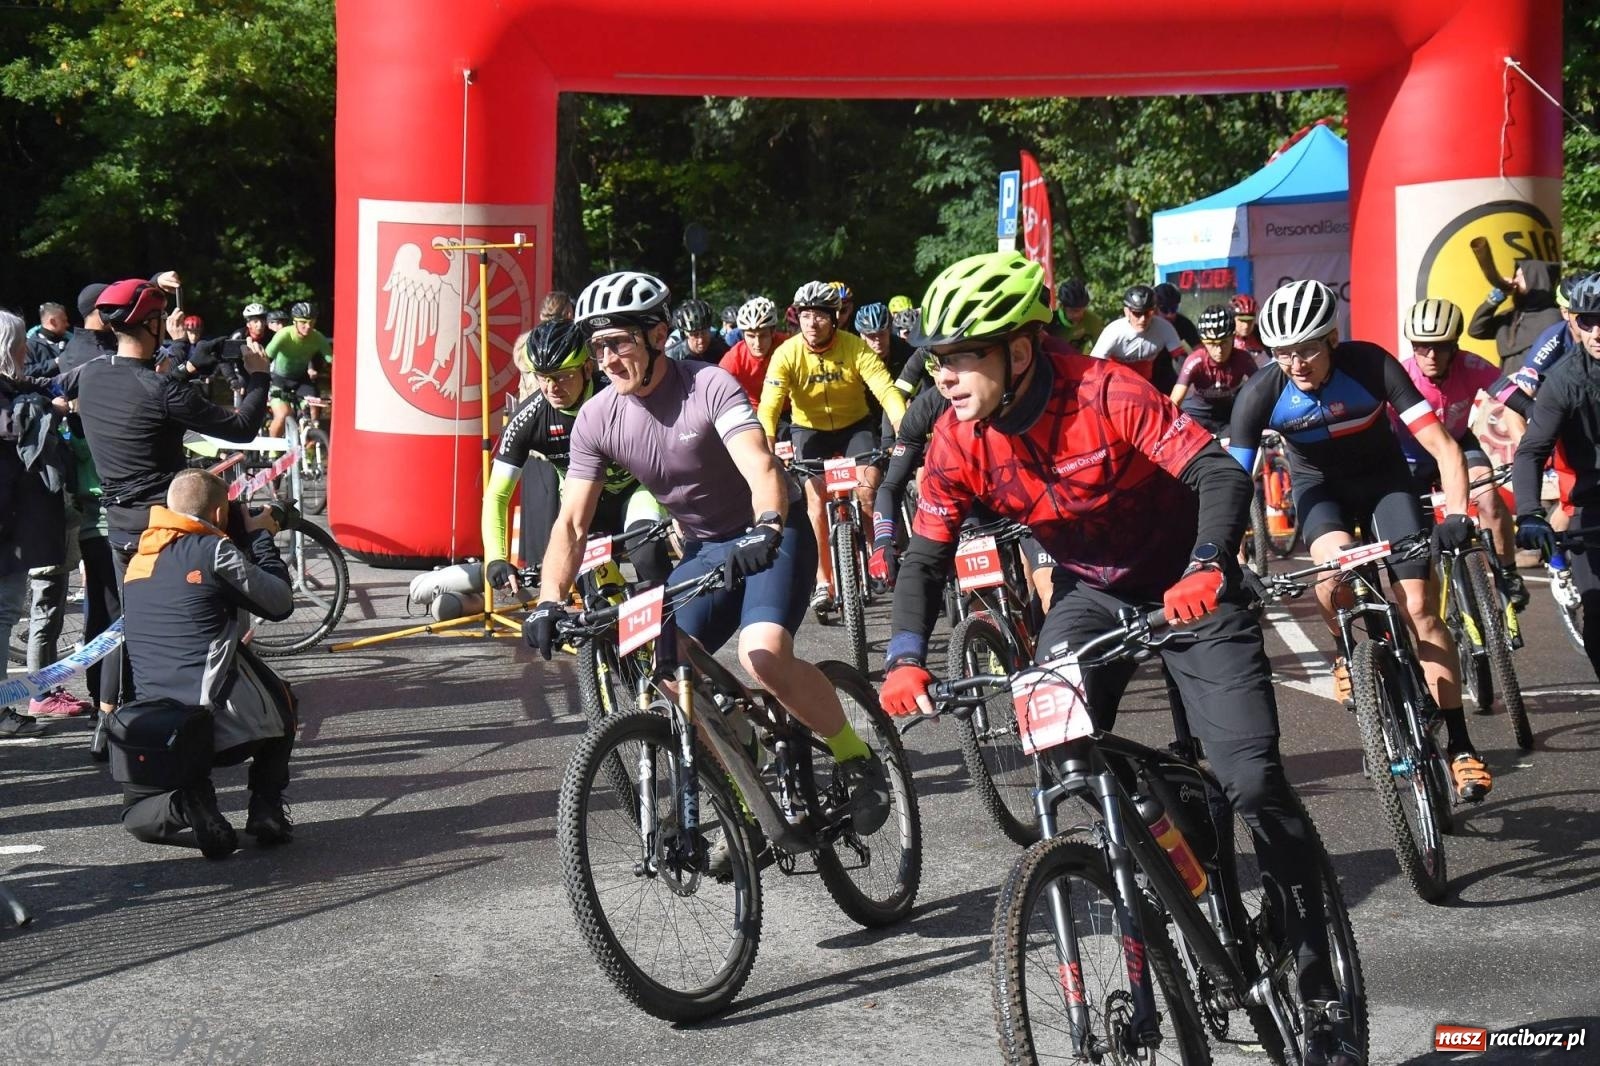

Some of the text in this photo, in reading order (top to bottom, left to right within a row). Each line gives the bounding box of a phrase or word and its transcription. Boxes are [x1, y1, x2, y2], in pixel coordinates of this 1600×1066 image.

[1002, 177, 1015, 219] P
[1265, 220, 1350, 237] PersonalBes
[1533, 334, 1560, 366] FENIX
[831, 469, 850, 480] 116
[964, 555, 990, 572] 119
[627, 607, 652, 632] 141
[1291, 885, 1306, 919] brick
